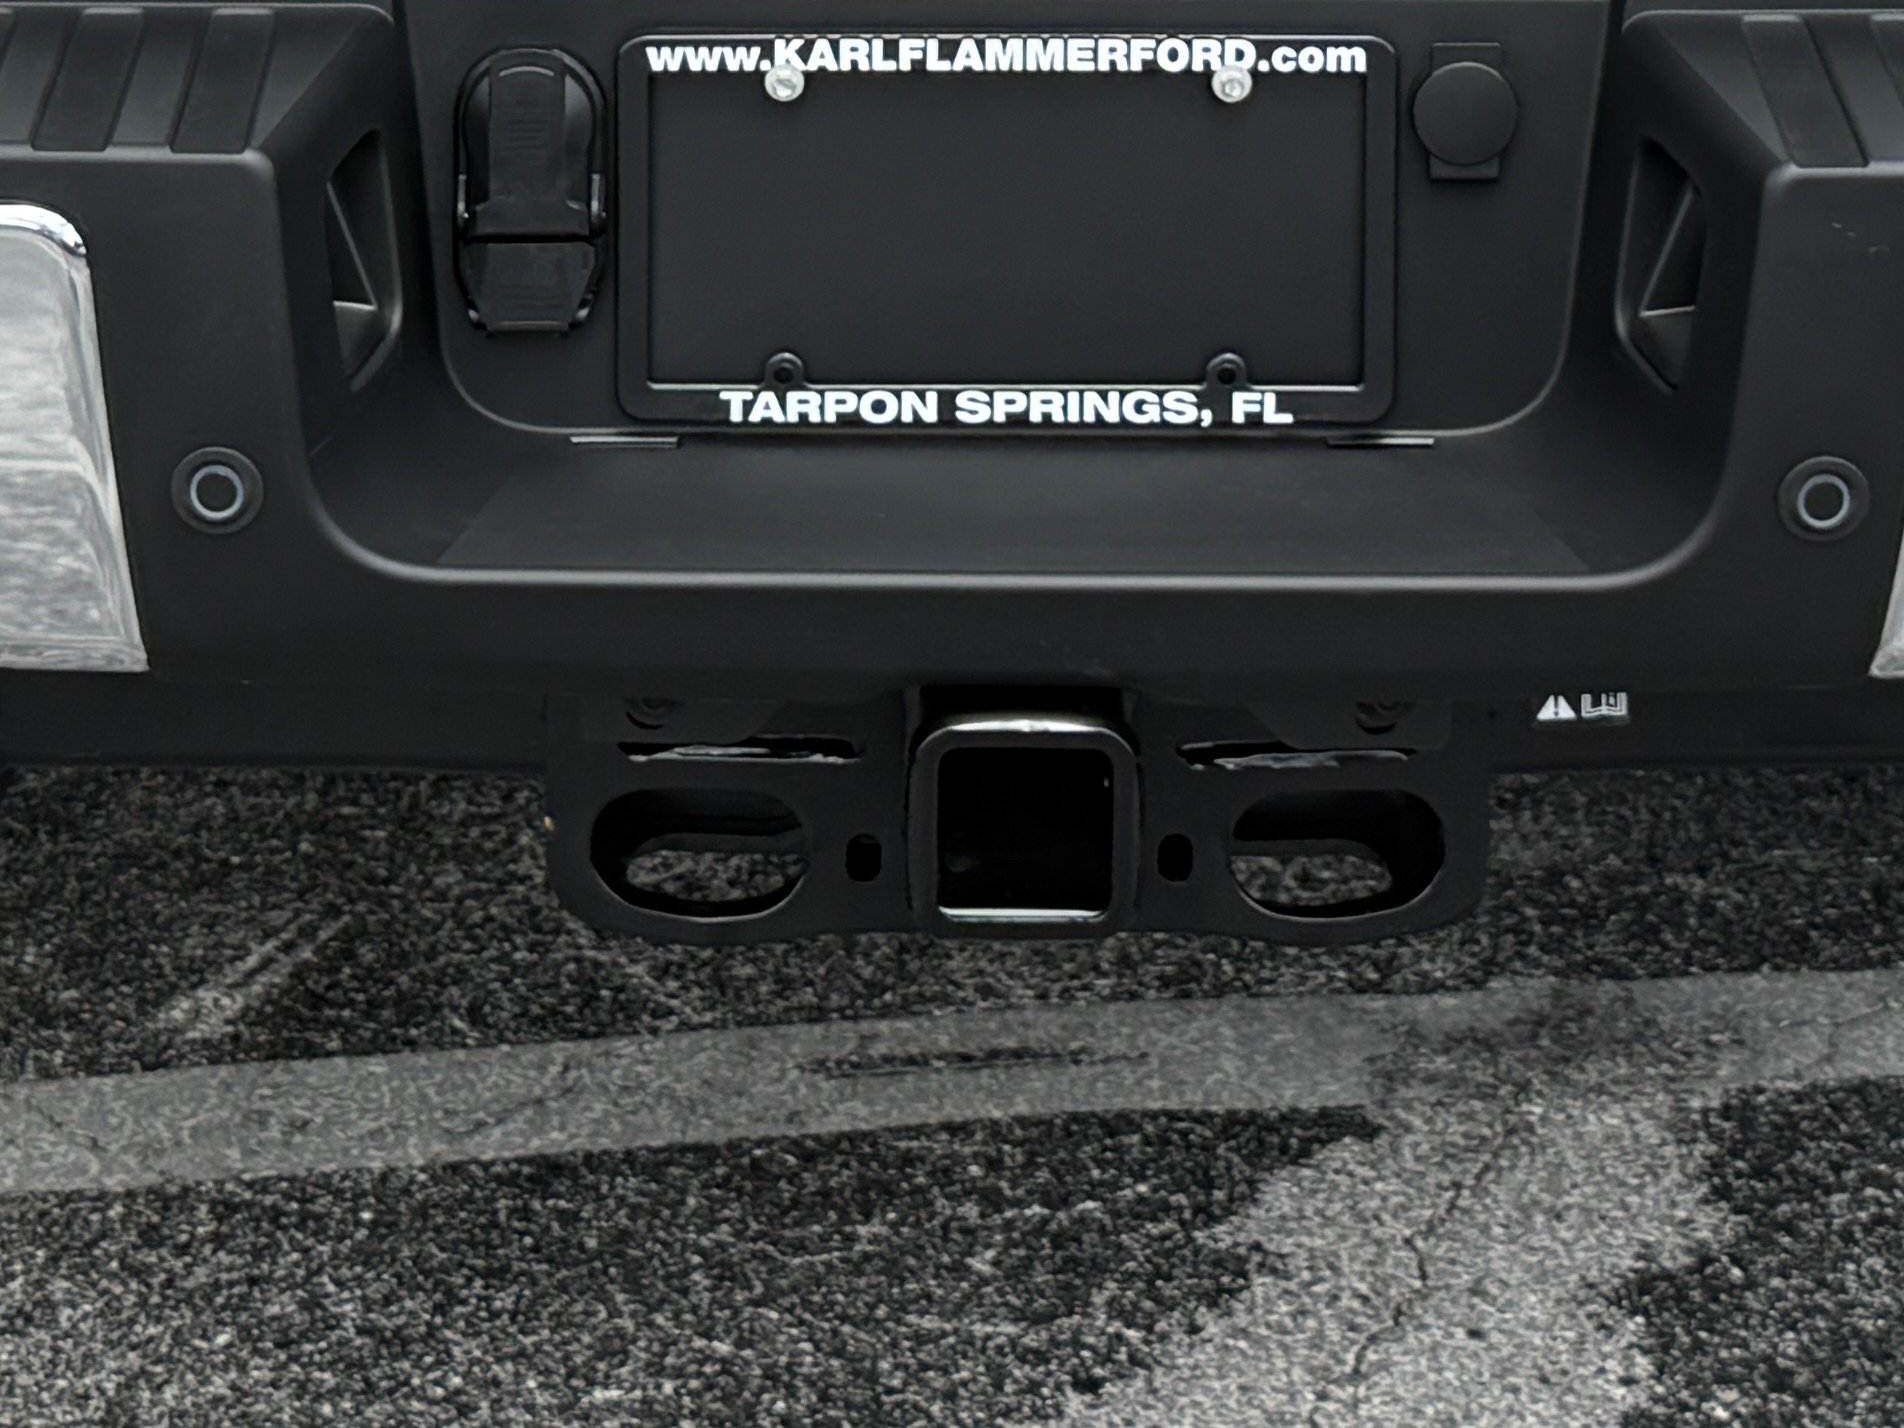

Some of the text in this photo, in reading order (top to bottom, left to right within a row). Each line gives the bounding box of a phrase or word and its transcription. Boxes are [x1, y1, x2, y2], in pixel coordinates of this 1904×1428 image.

[646, 37, 1367, 73] www.KARLFLAMMERFORD.com
[720, 390, 1294, 427] TARPON SPRINGS, FL
